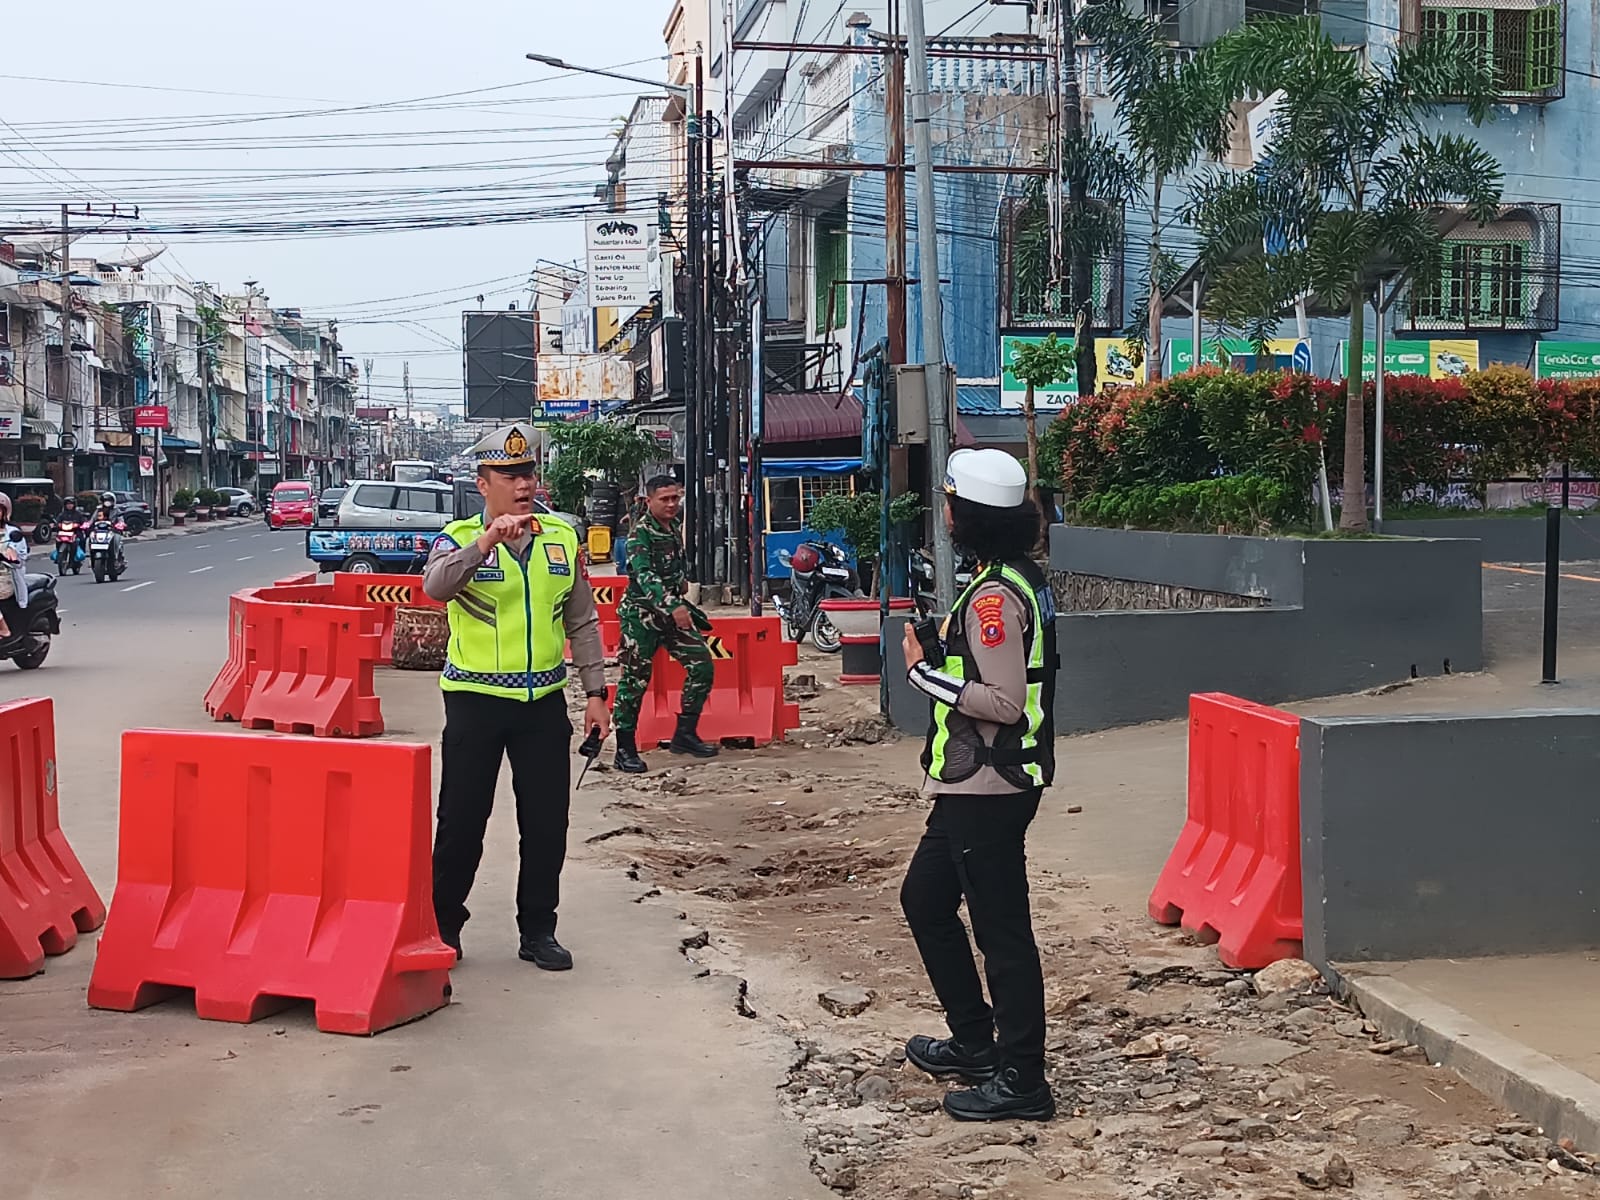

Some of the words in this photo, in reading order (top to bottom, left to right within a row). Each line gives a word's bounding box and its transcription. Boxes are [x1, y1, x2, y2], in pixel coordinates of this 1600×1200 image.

[614, 274, 625, 282] Up
[595, 294, 616, 302] Spare
[1543, 354, 1589, 365] GrabCar
